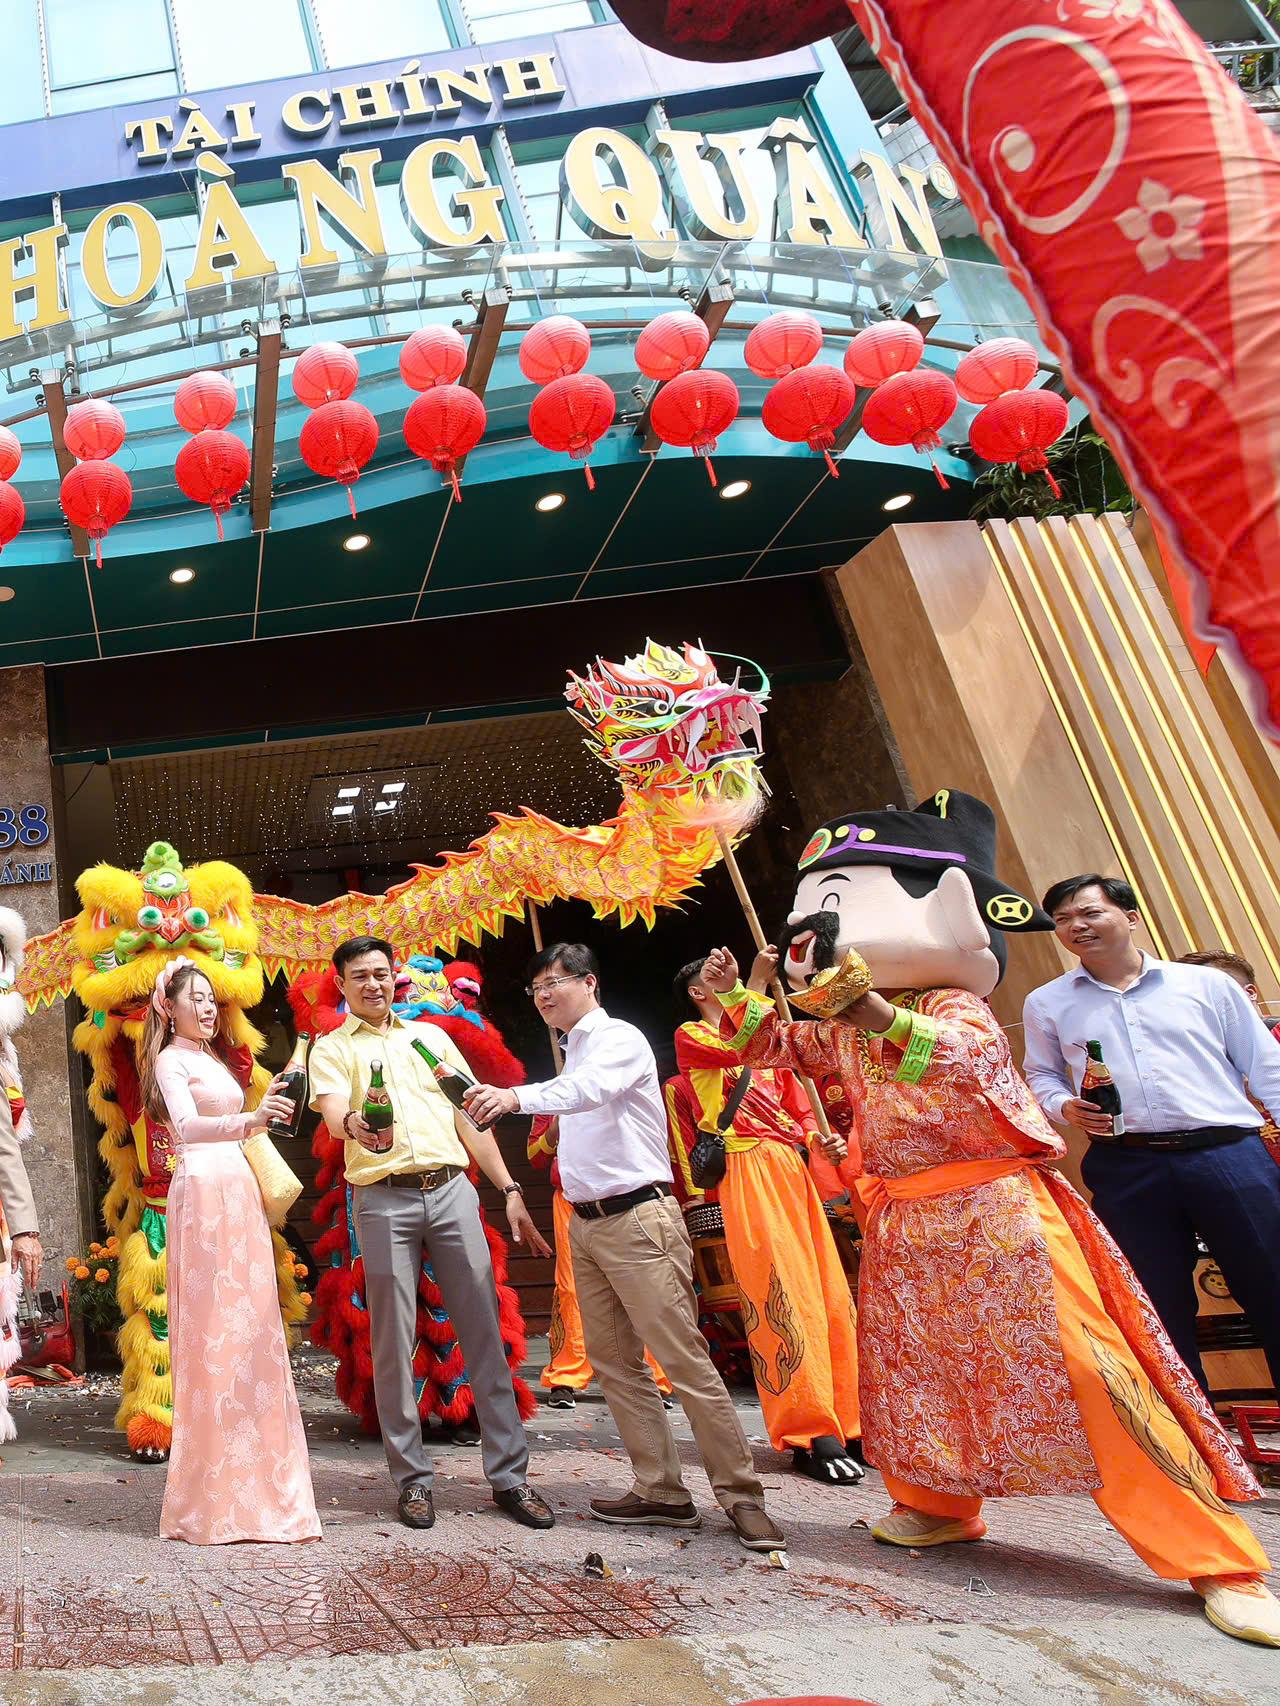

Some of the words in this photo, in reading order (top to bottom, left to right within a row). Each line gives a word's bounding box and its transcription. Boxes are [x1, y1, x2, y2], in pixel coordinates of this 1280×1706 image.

[125, 98, 261, 163] TÀI
[282, 59, 566, 134] CHÍNH
[563, 116, 949, 281] QUÂN
